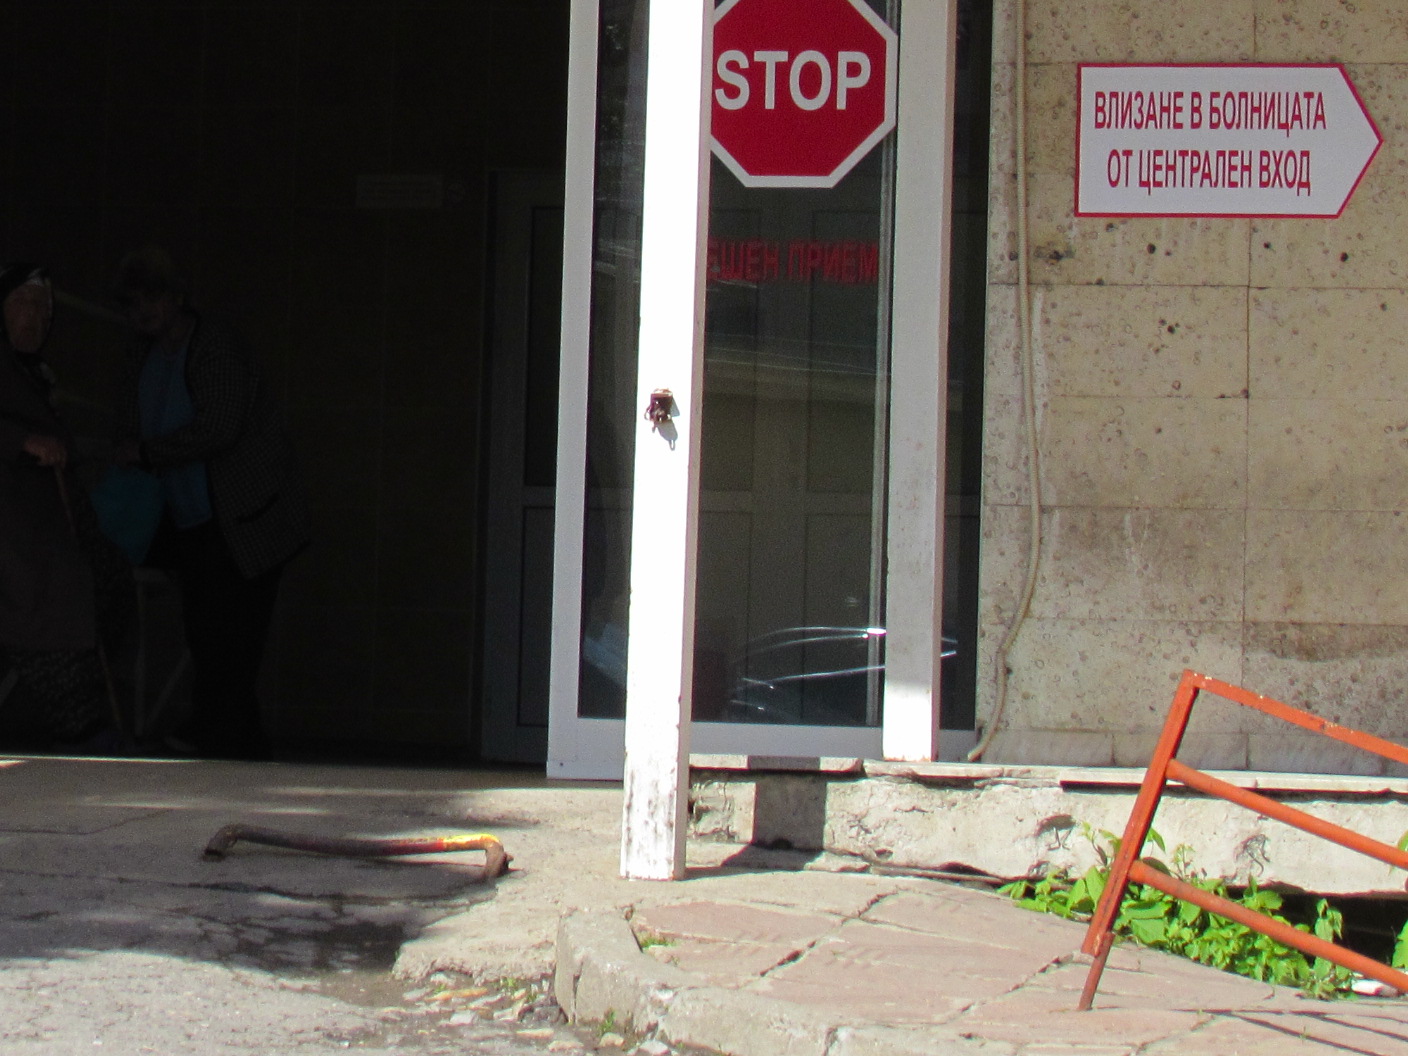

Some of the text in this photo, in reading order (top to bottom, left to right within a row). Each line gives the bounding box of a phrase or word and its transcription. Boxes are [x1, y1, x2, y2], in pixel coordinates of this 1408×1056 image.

[714, 49, 872, 111] STOP
[1095, 91, 1327, 137] ВЛИЗАНЕ В БОЛНИЦАТА
[1108, 149, 1311, 196] ОТ ЦЕНТРАЛЕН ВХОД
[788, 238, 879, 285] ПРИЕМ
